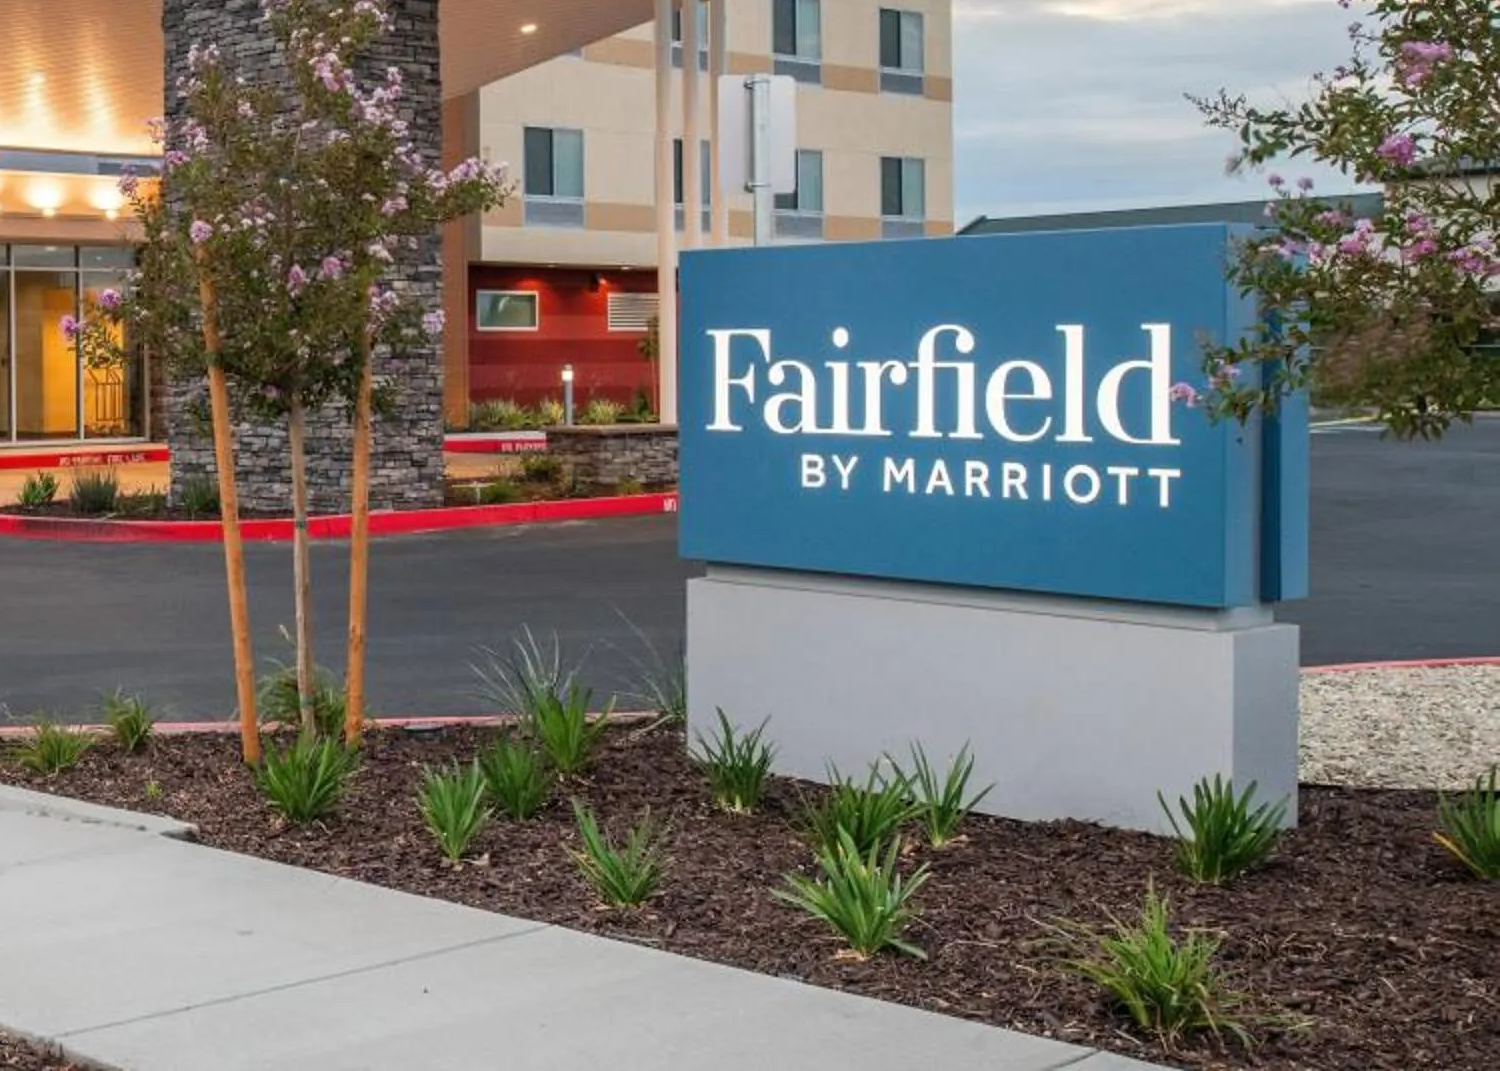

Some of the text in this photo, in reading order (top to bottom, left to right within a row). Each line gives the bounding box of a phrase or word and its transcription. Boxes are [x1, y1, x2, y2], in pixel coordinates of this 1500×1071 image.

[705, 323, 1182, 445] Fairfield
[801, 454, 1182, 508] BY MARRIOTT
